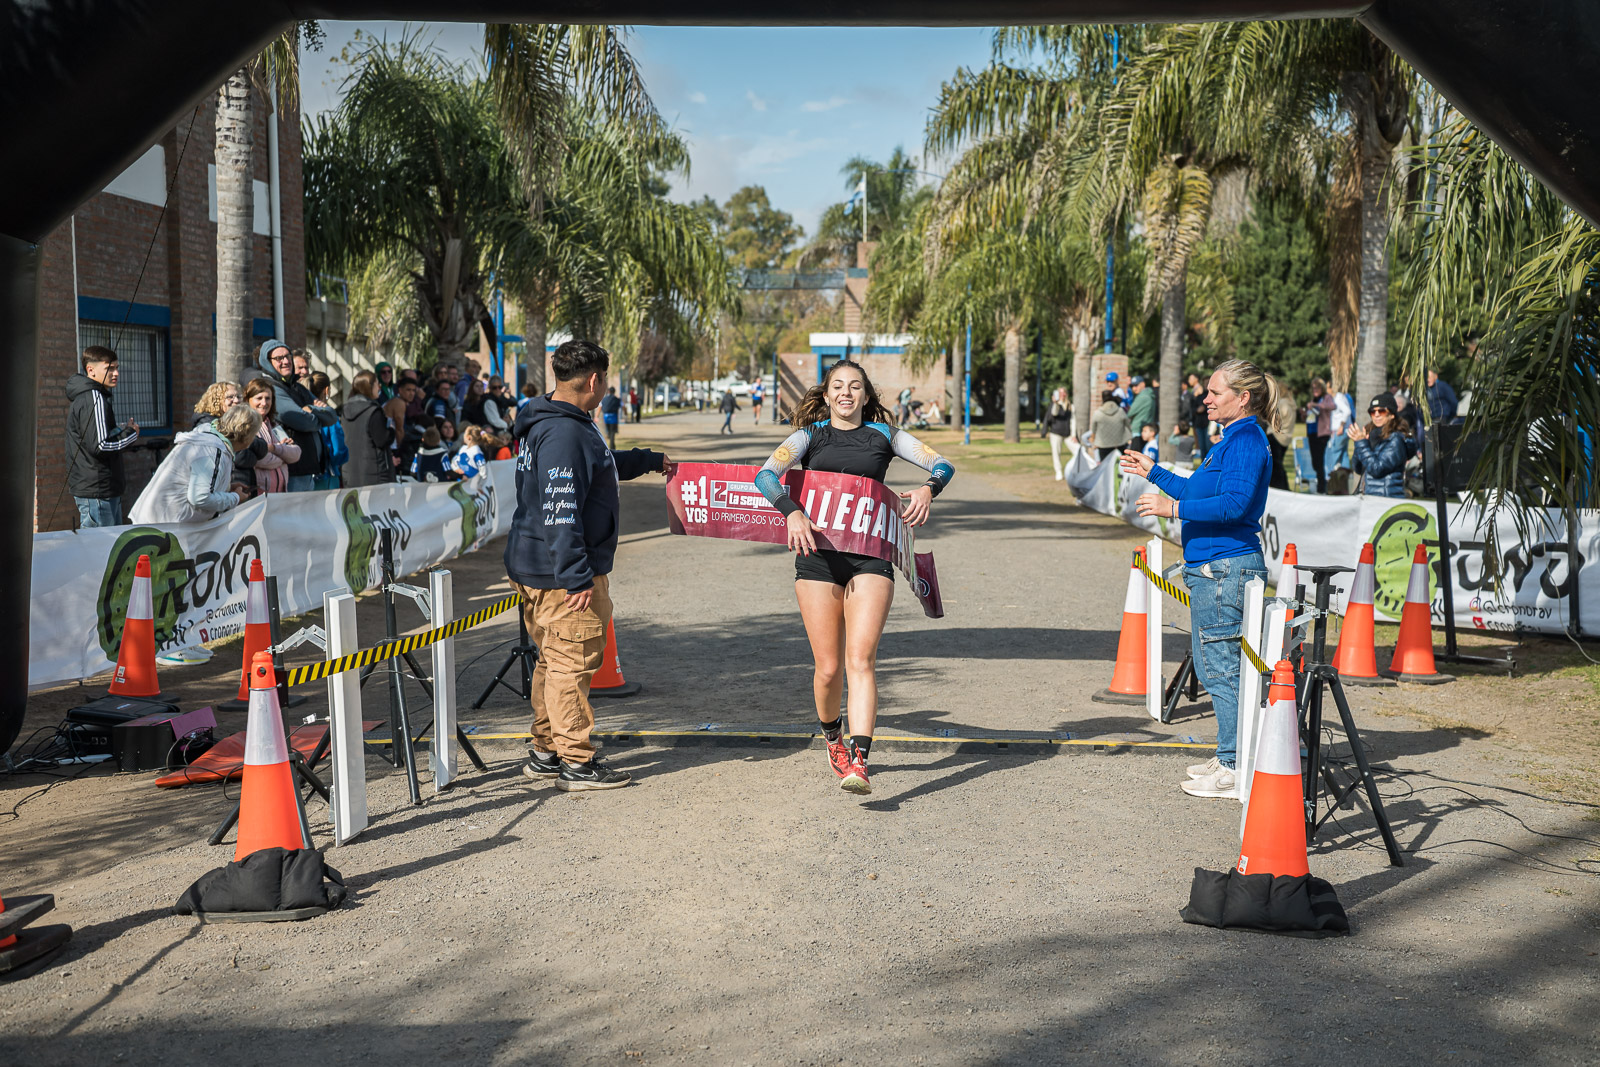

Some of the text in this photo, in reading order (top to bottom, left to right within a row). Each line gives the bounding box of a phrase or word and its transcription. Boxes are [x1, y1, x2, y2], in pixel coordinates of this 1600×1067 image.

[548, 466, 574, 480] El club
[681, 475, 708, 507] #1
[729, 483, 749, 491] GRUPO
[555, 499, 577, 514] grand
[685, 507, 708, 524] VOS
[711, 511, 785, 527] LO PRIMERO SOS VOS
[1482, 600, 1552, 619] @cronorav
